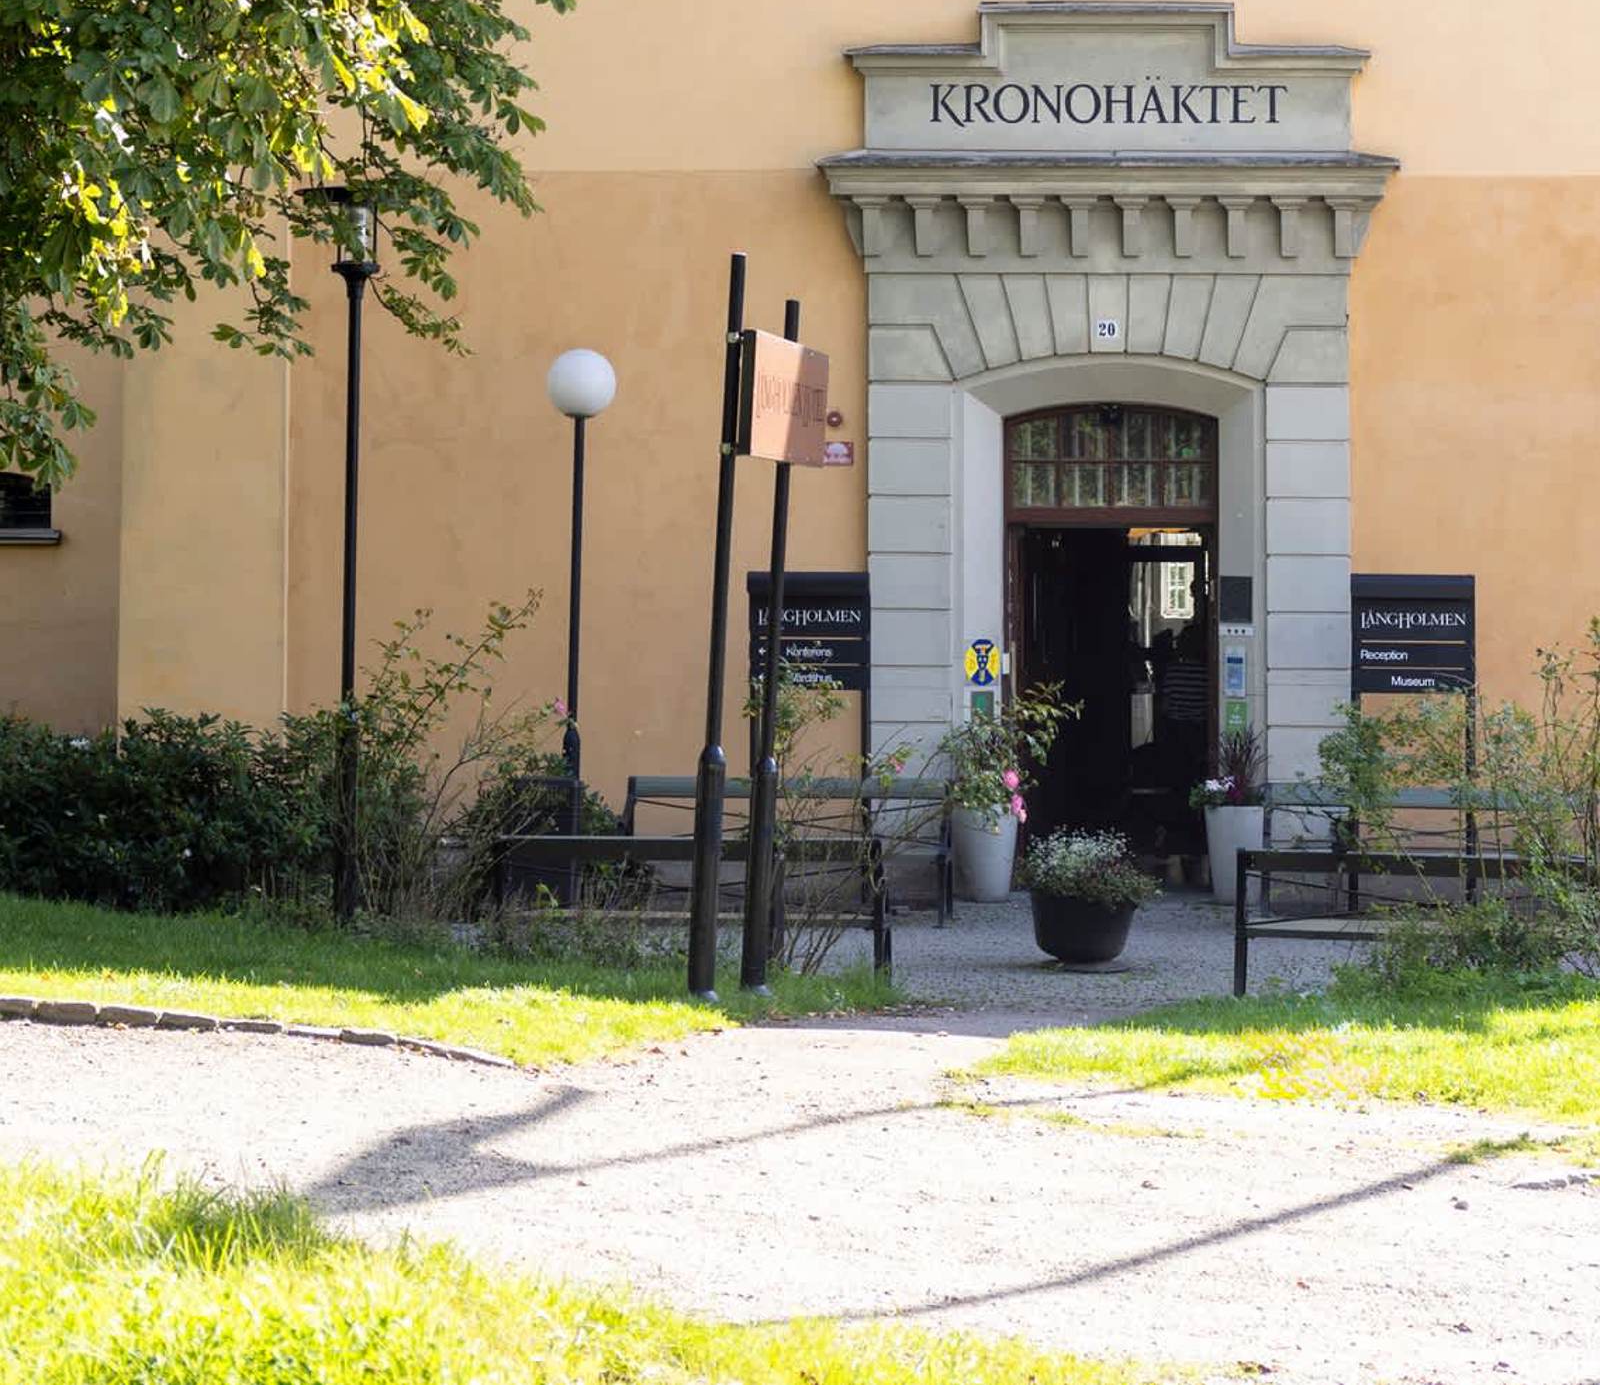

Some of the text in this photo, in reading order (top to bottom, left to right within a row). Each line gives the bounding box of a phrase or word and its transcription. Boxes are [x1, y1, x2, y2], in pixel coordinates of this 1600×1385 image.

[930, 75, 1288, 127] KRONOHÄKTET
[1098, 322, 1116, 337] 20
[758, 608, 861, 626] LGHOLMEN
[1361, 609, 1467, 629] LÅNGHOLMEN
[1360, 649, 1408, 661] Reception
[1391, 675, 1436, 687] Museum
